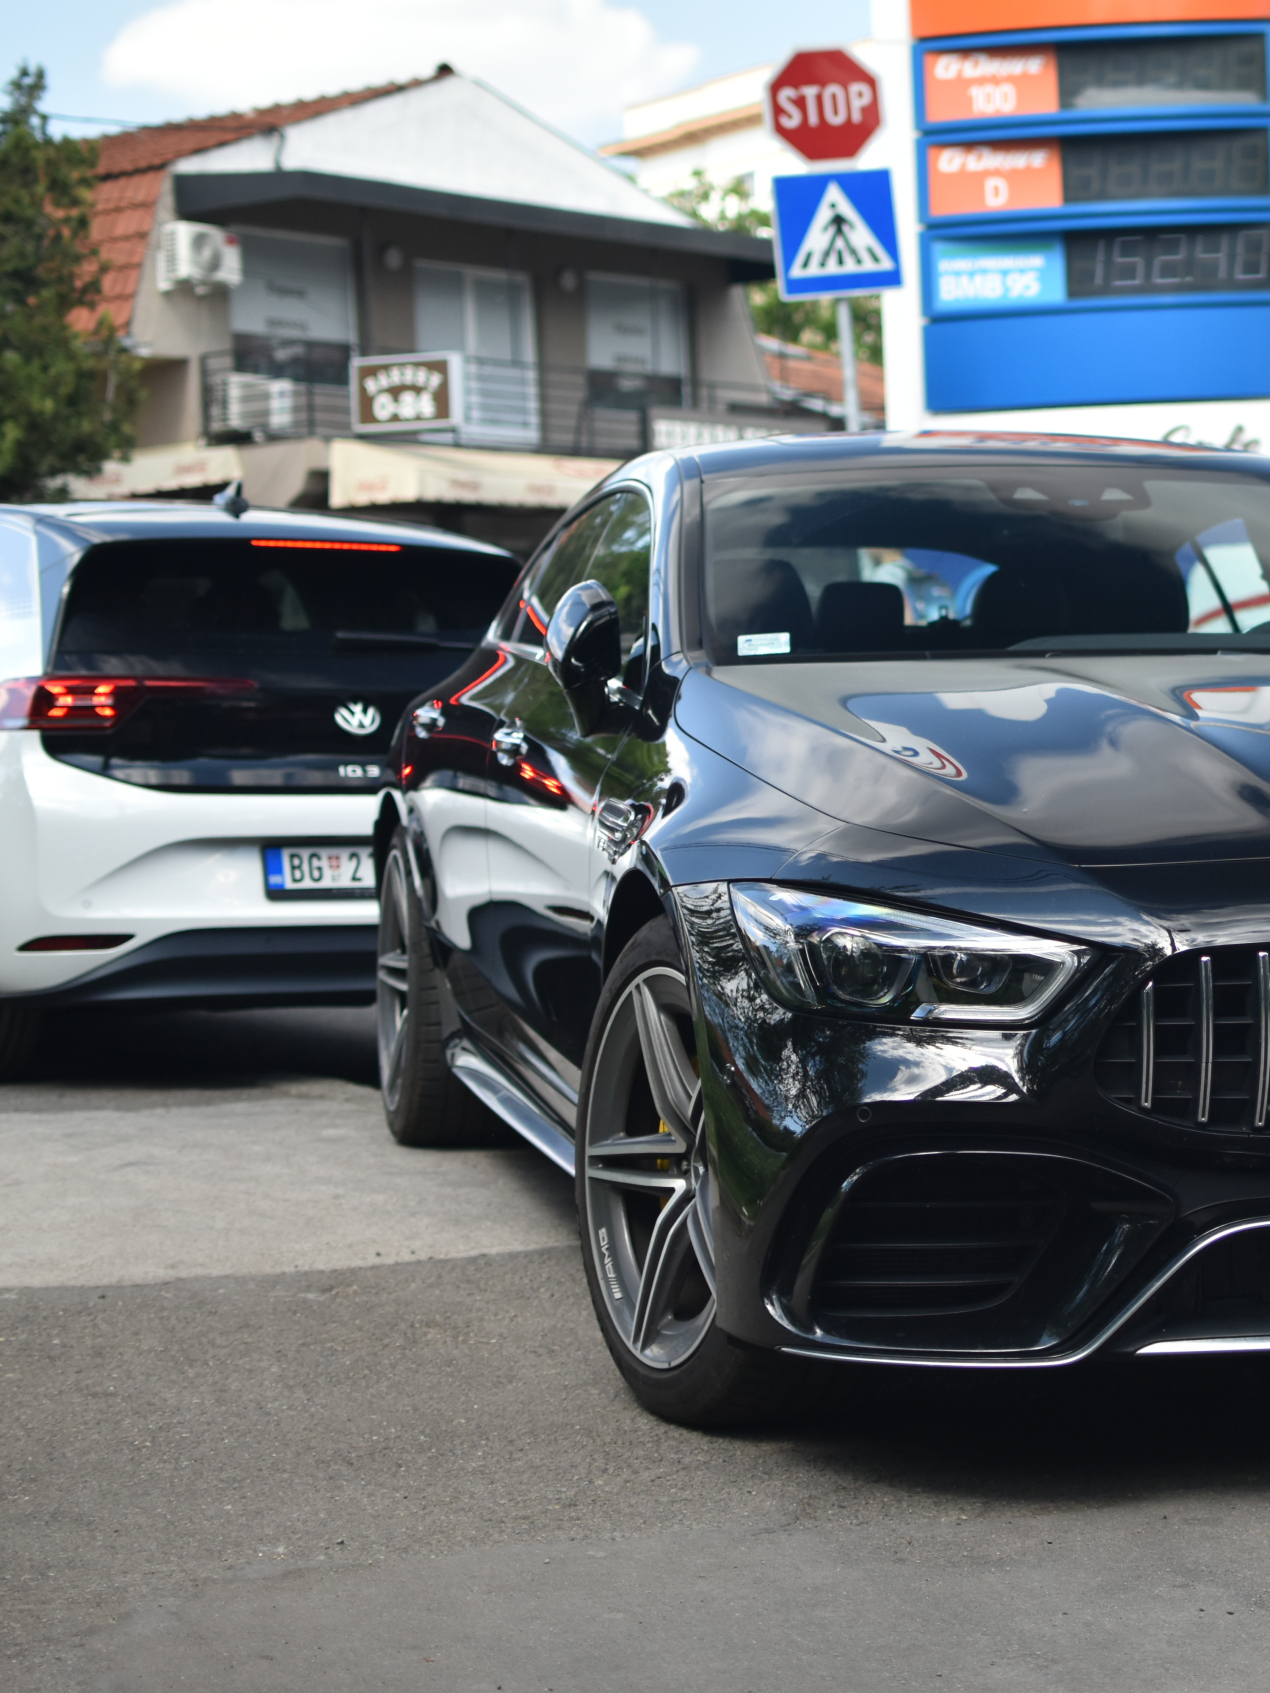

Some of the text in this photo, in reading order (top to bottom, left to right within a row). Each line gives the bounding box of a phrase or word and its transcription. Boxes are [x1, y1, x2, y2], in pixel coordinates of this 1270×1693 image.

[776, 81, 873, 130] STOP
[967, 82, 1027, 114] 100
[984, 176, 1009, 208] D
[1094, 230, 1270, 287] 152.40
[940, 269, 1041, 300] BMB 95
[289, 852, 324, 883] BG
[599, 1227, 618, 1284] AMG
